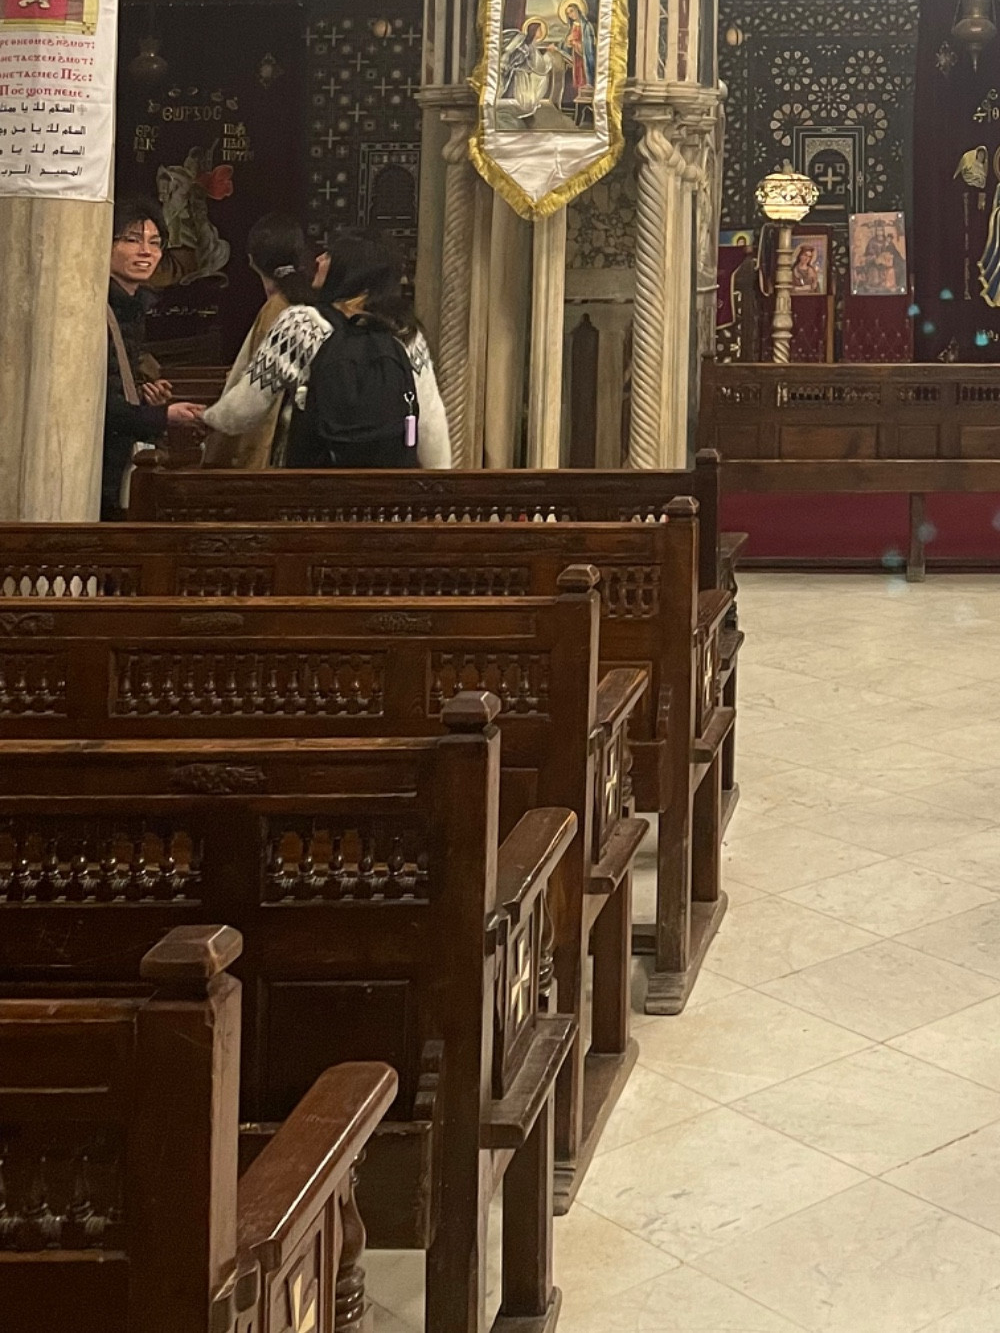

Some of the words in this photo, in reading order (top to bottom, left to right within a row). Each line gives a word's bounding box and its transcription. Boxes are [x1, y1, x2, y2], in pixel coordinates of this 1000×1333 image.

[49, 103, 75, 114] السلام
[62, 126, 87, 136] السلام
[52, 145, 86, 157] السلام
